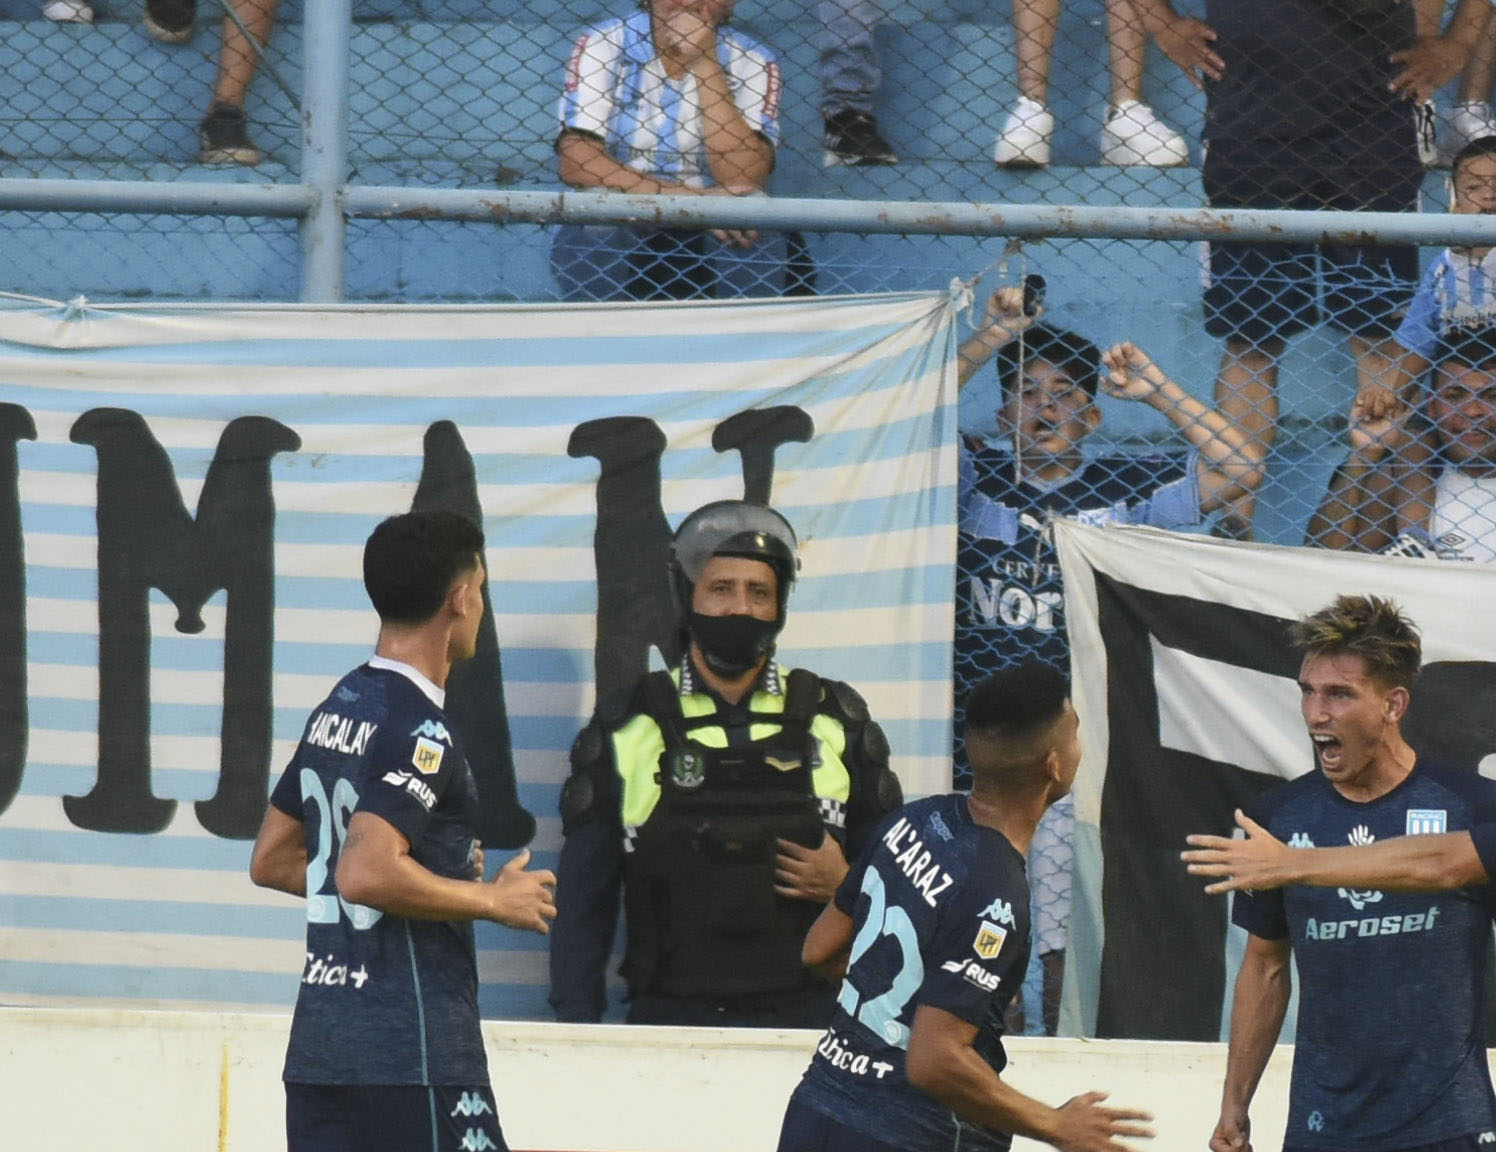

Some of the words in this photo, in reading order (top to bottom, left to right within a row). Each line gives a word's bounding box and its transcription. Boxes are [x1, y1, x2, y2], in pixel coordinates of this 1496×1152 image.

[407, 777, 439, 809] RUS
[1305, 907, 1440, 940] Aeroset
[837, 865, 924, 1050] 22
[966, 964, 1001, 991] RUS
